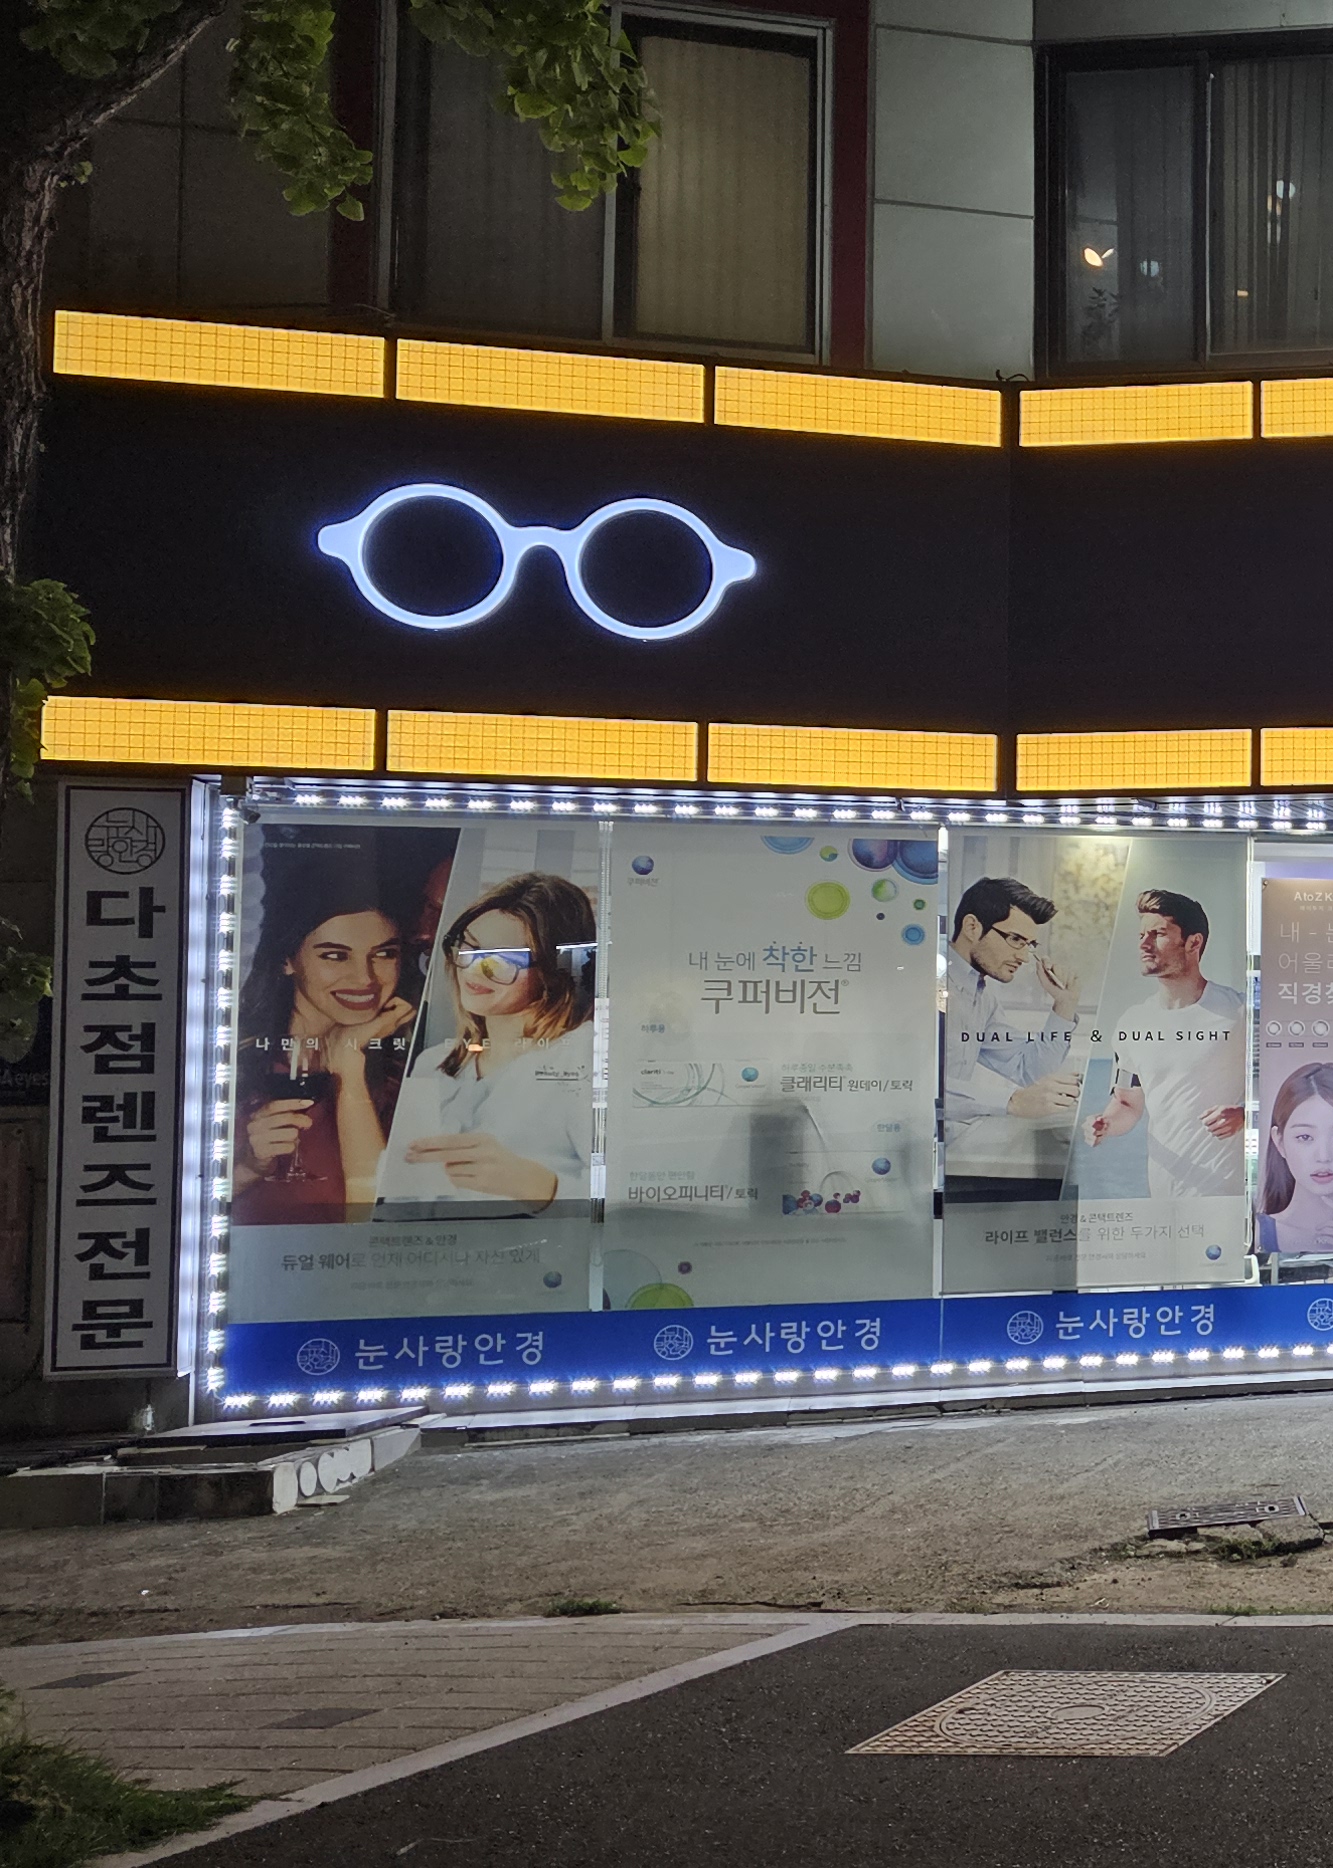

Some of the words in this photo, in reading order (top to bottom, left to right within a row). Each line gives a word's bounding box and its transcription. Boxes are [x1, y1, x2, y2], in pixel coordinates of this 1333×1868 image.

[1280, 921, 1300, 943] 내
[689, 951, 709, 972] 내
[714, 951, 756, 972] 눈에
[762, 940, 818, 974] 착한
[823, 951, 863, 973] 느낌
[256, 1036, 320, 1051] 나만의
[961, 1031, 1013, 1043] DUAL
[1027, 1030, 1072, 1043] LIFE
[1090, 1029, 1104, 1043] &
[1118, 1030, 1165, 1042] DUAL
[1175, 1029, 1231, 1042] SIGHT
[984, 1230, 1029, 1245] 라이프
[1096, 1226, 1125, 1243] 위한
[1130, 1225, 1172, 1241] 두가지
[1177, 1224, 1205, 1239] 선택
[280, 1253, 314, 1272] 듀얼
[317, 1251, 367, 1271] 웨어로
[1055, 1303, 1215, 1341] 눈사랑안경
[706, 1317, 882, 1356] 눈사랑안경
[355, 1330, 547, 1372] 눈사랑안경
